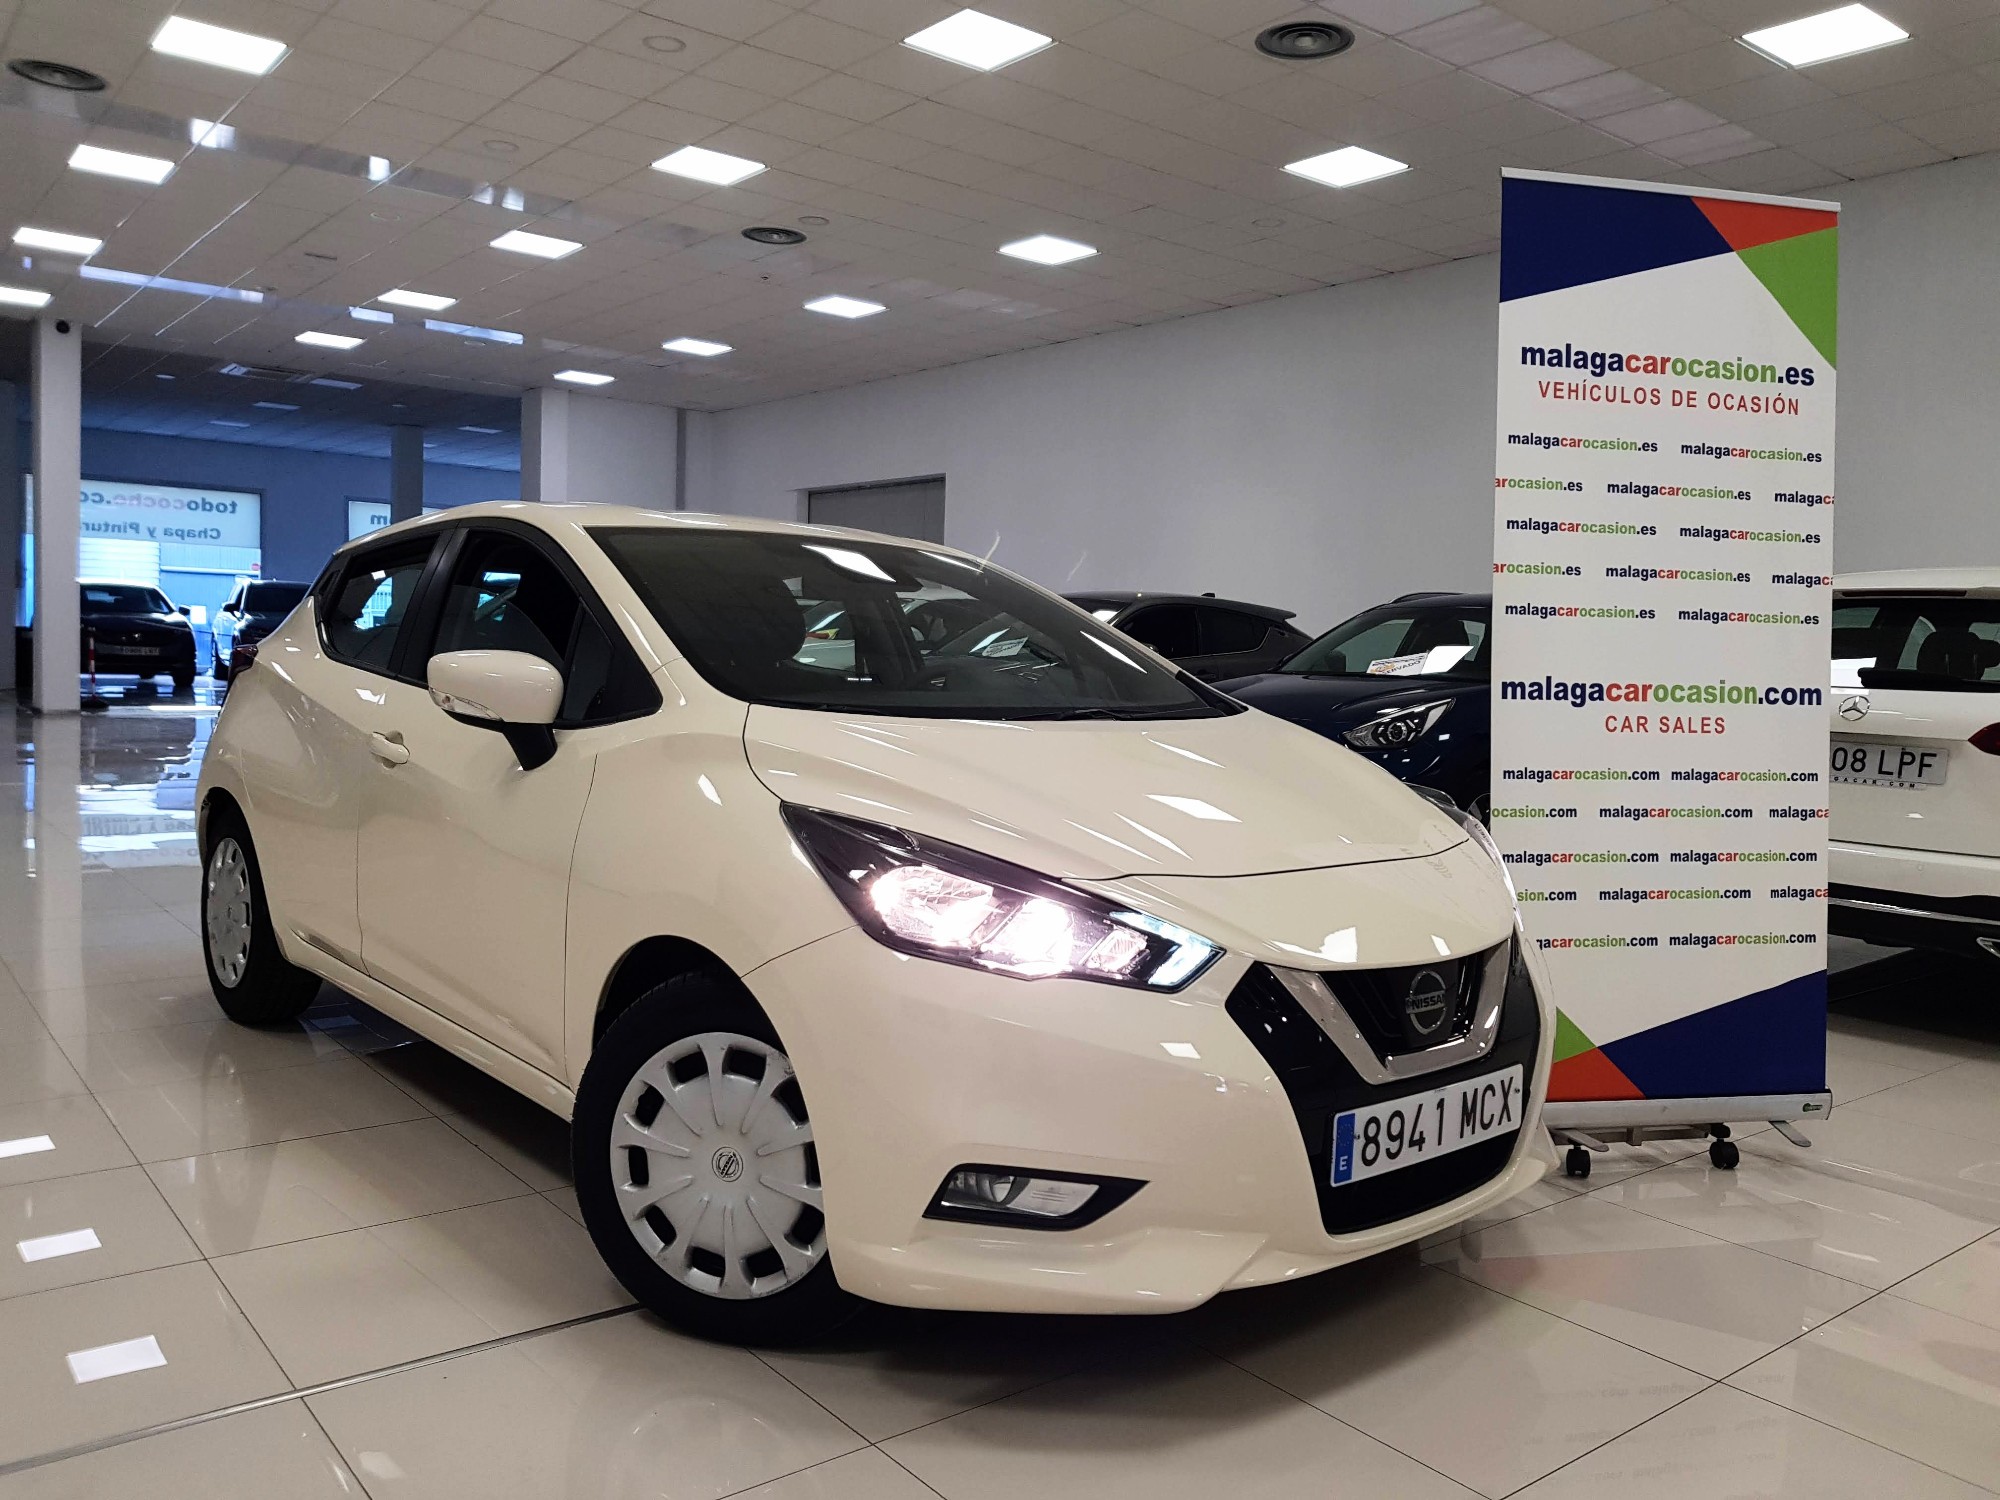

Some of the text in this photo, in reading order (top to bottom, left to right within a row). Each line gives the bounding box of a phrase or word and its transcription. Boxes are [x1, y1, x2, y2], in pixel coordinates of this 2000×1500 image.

[1521, 343, 1815, 386] malagacarocasion.es
[1538, 379, 1799, 416] VEHÍCULOS DE OCASIÓN
[1507, 432, 1822, 462] malagacarocasion.es malagacarocasion.es
[1607, 481, 1752, 501] malagacarocasion.es
[1506, 518, 1820, 543] malagacarocasion.es malagacarocasion.es
[1605, 565, 1750, 582] malagacarocasion.es
[1771, 572, 1833, 588] malagac
[1505, 603, 1820, 625] malagacarocasion.es malagacarocasion.es
[1500, 676, 1822, 707] malagacarocasion.com
[1605, 715, 1726, 735] CAR SALES
[1831, 746, 1938, 779] 08 LPF
[1502, 767, 1819, 783] malagacarocasion.com malagacarocasion.com
[1492, 805, 1577, 818] ocasion.com
[1599, 805, 1753, 822] malagacarocasion.com
[1502, 850, 1817, 867] malagacarocasion.com malagacarocasion.com
[1599, 887, 1751, 902] malagacarocasion.com
[1669, 932, 1817, 947] malagacarocasion.com
[1361, 1076, 1515, 1167] 8941 MCX
[1339, 1155, 1348, 1171] E
